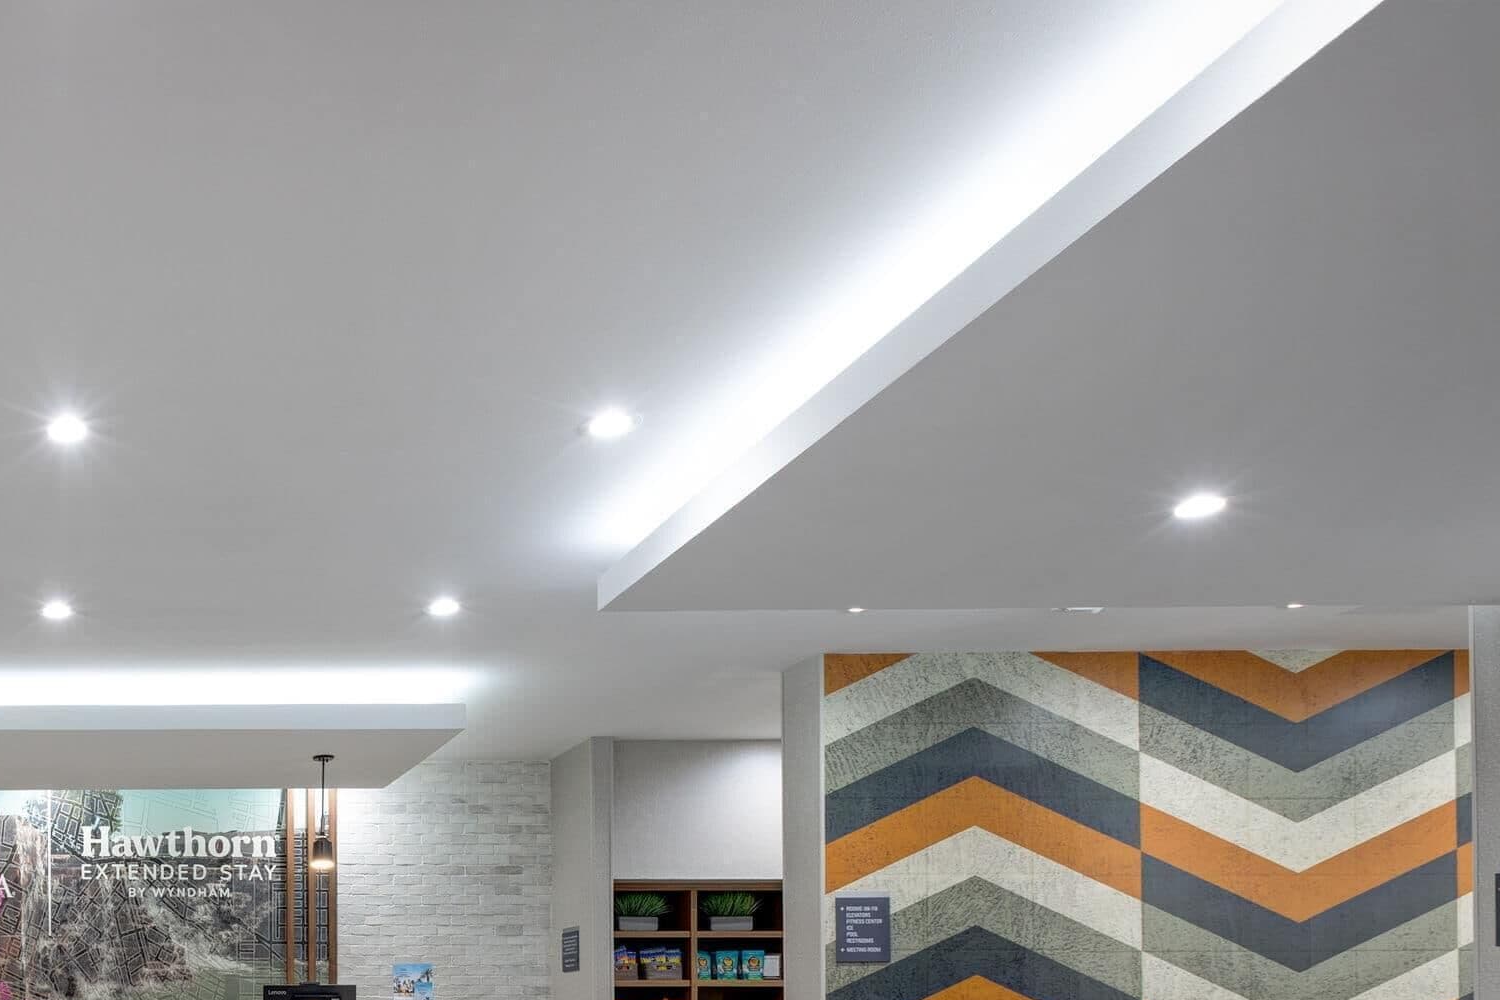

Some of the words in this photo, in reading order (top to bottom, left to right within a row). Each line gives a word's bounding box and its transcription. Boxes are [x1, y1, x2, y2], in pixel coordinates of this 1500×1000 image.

[81, 826, 277, 858] Hawthorn
[80, 864, 207, 881] EXTENDED
[220, 864, 277, 881] STAY
[128, 887, 146, 898] BY
[153, 887, 231, 898] WYNDHAM
